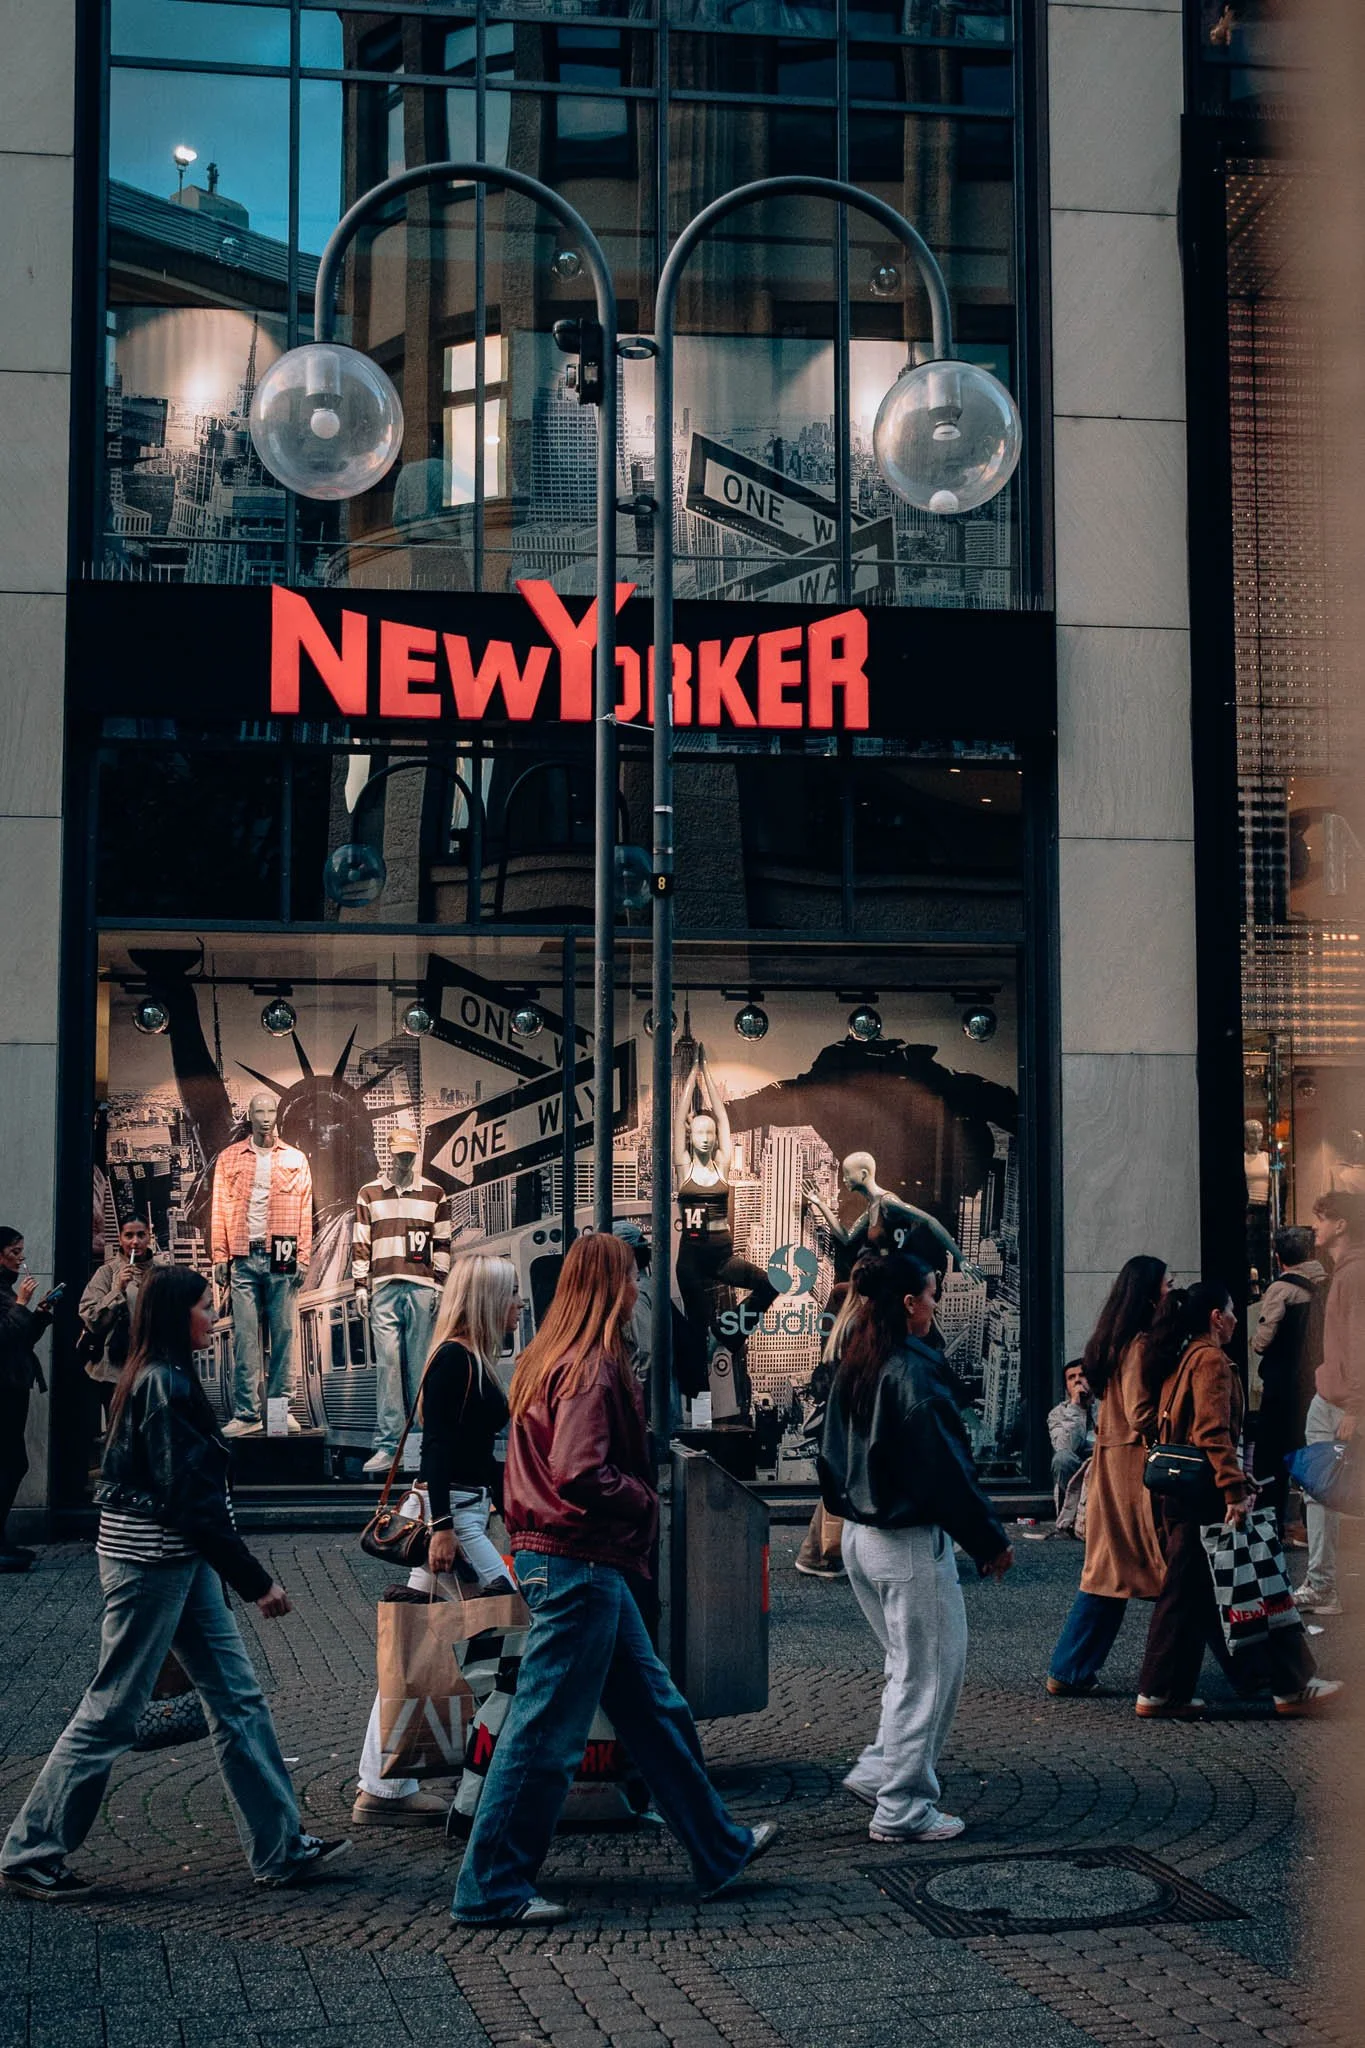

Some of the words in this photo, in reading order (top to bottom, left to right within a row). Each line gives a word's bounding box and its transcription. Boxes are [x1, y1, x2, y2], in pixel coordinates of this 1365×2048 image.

[723, 474, 784, 526] ONE
[658, 876, 666, 890] 8
[451, 1119, 507, 1168] ONE
[720, 1303, 837, 1336] studio
